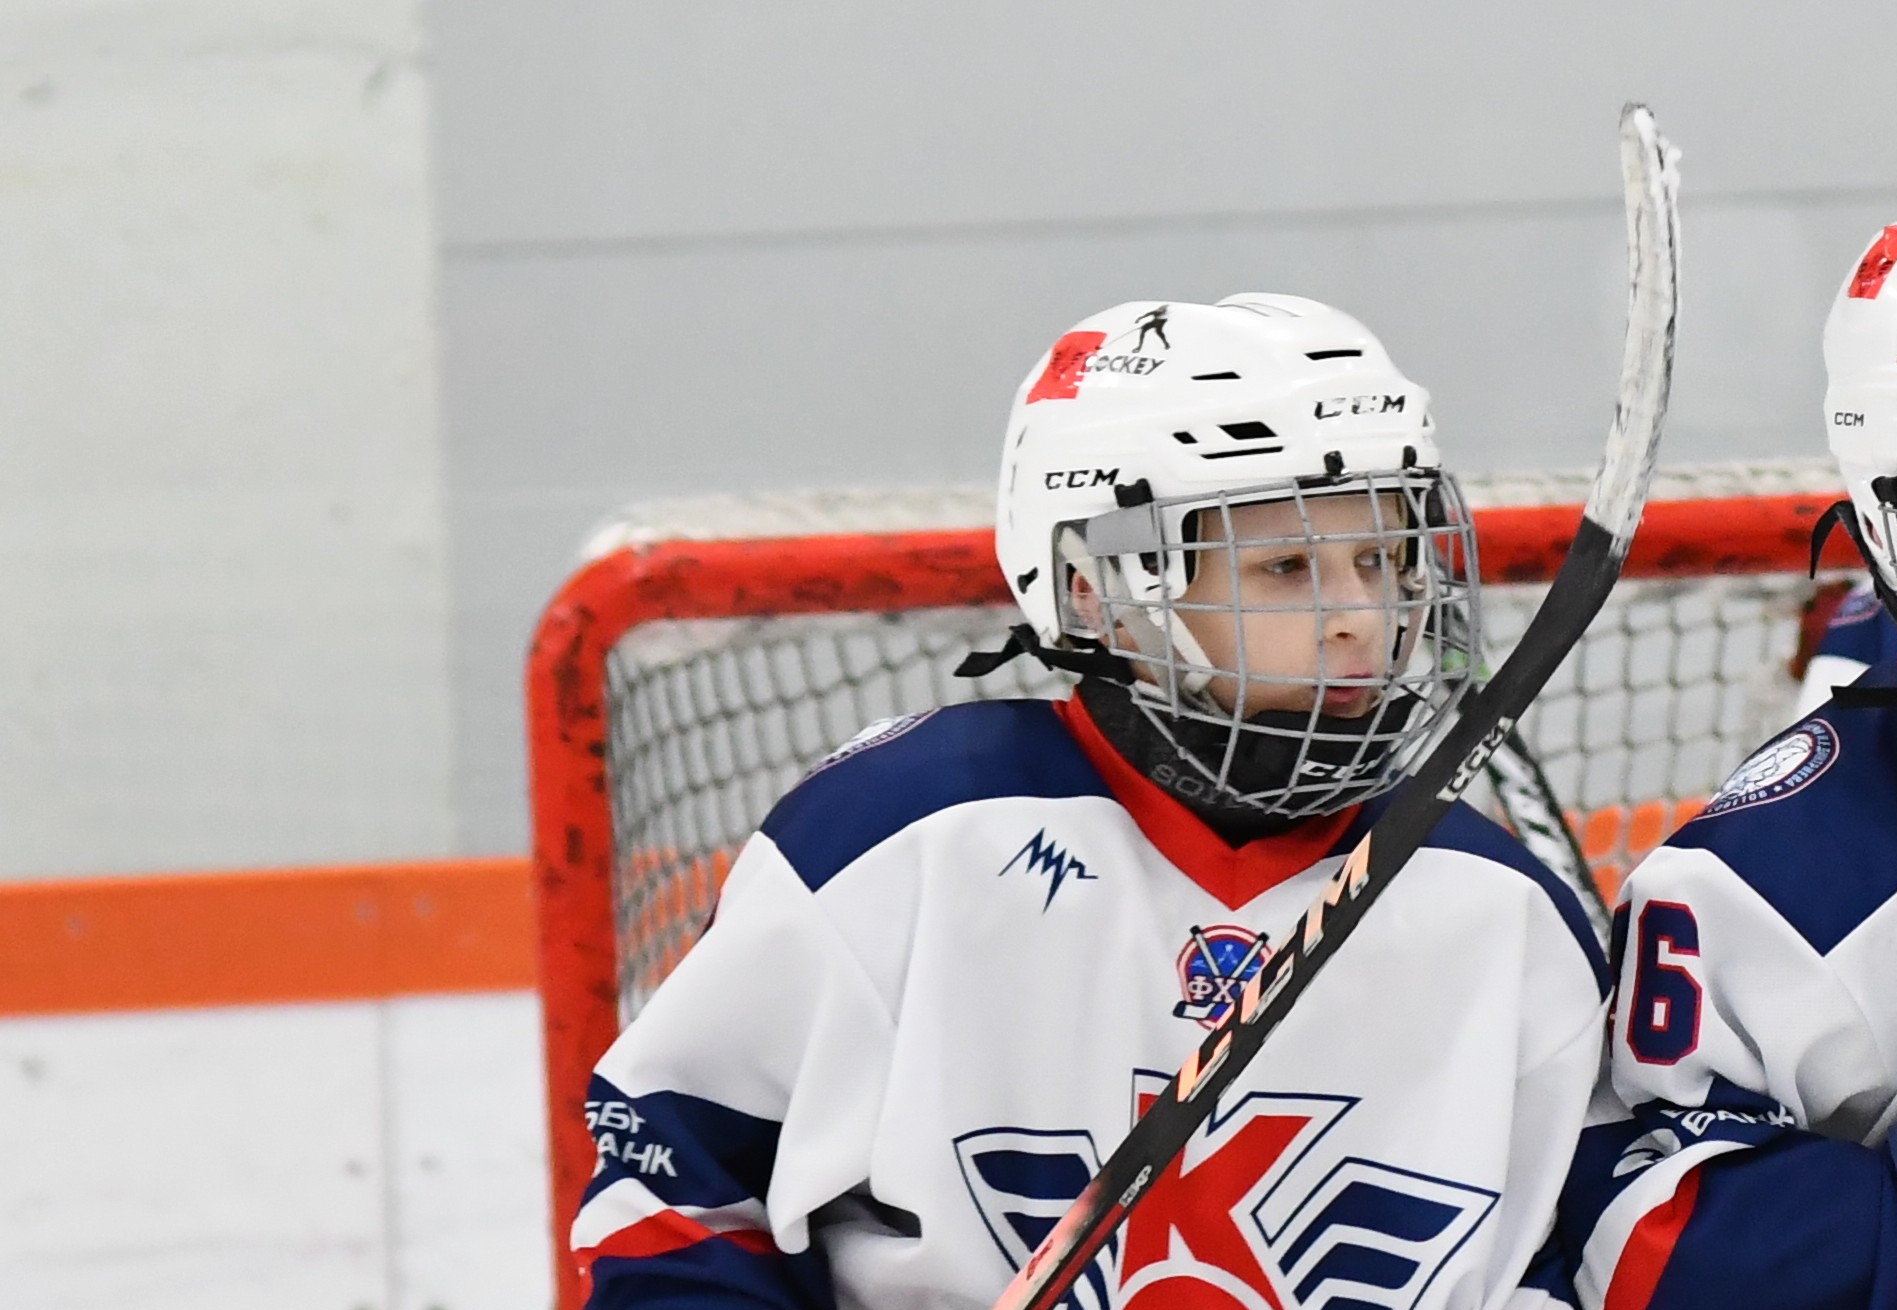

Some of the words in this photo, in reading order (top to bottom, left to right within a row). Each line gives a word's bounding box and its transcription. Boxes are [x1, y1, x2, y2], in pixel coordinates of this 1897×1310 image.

[1314, 394, 1406, 420] CCM
[1834, 411, 1864, 427] CCM
[1044, 467, 1121, 491] CCM
[1446, 722, 1509, 796] CCM
[1188, 974, 1247, 1004] ФХ
[592, 1131, 678, 1178] АНК
